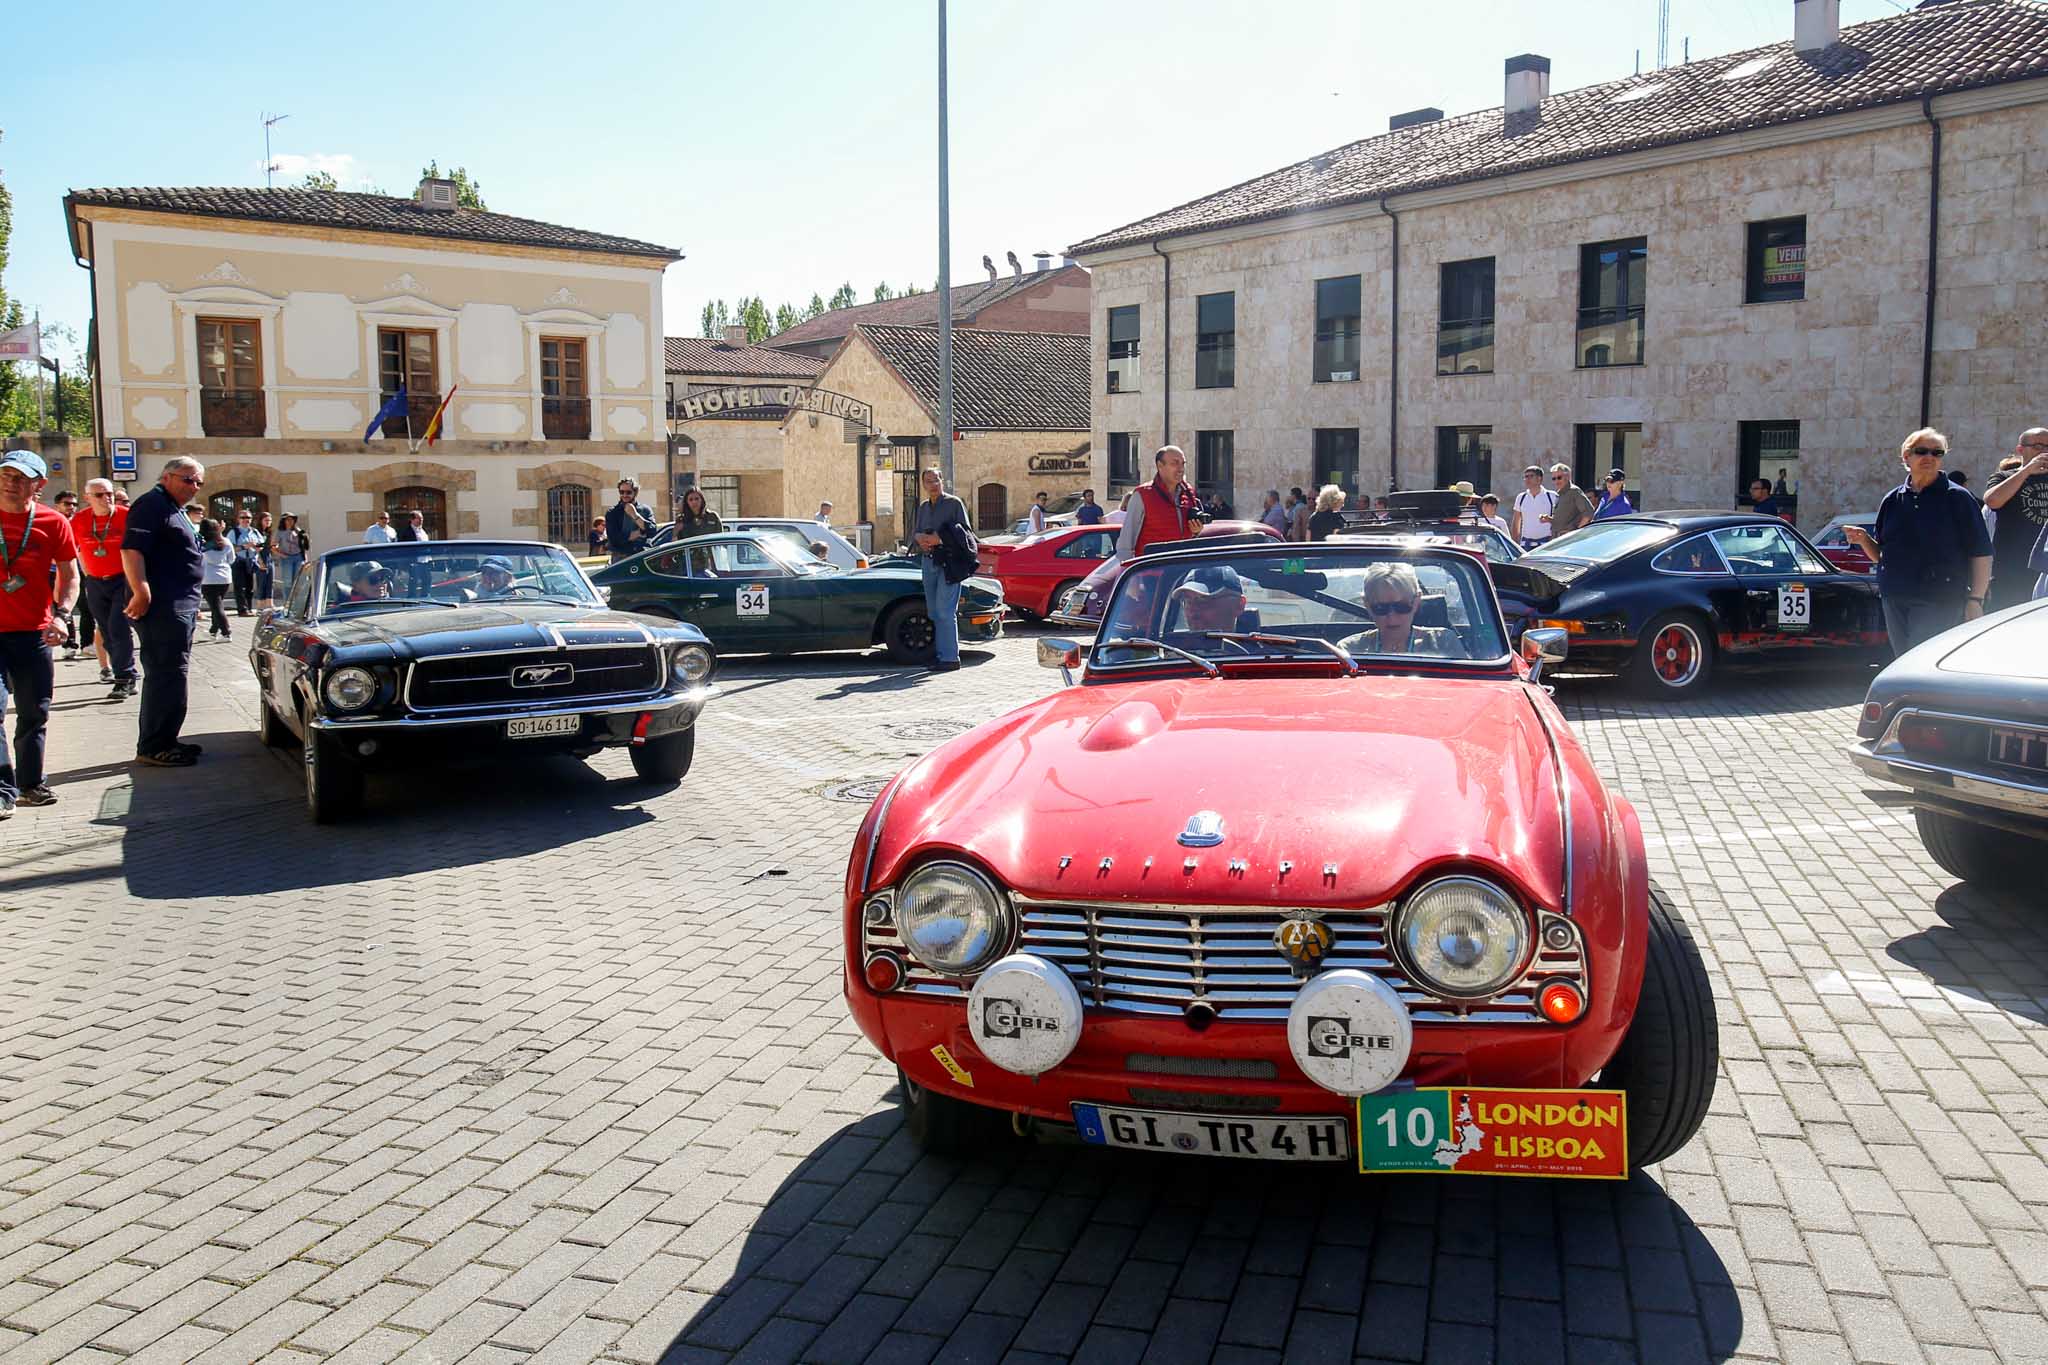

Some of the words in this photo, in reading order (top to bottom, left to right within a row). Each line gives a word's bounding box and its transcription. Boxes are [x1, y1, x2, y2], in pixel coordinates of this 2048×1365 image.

[683, 386, 764, 419] HOTEL
[778, 386, 865, 419] CASINO
[741, 593, 765, 610] 34
[1783, 595, 1806, 617] 35
[1058, 855, 1339, 879] TRIUMPH
[1376, 1106, 1436, 1148] 10
[1477, 1102, 1619, 1128] LONDON
[1108, 1113, 1165, 1147] GI
[1198, 1120, 1259, 1155] TR
[1493, 1135, 1607, 1161] LISBOA
